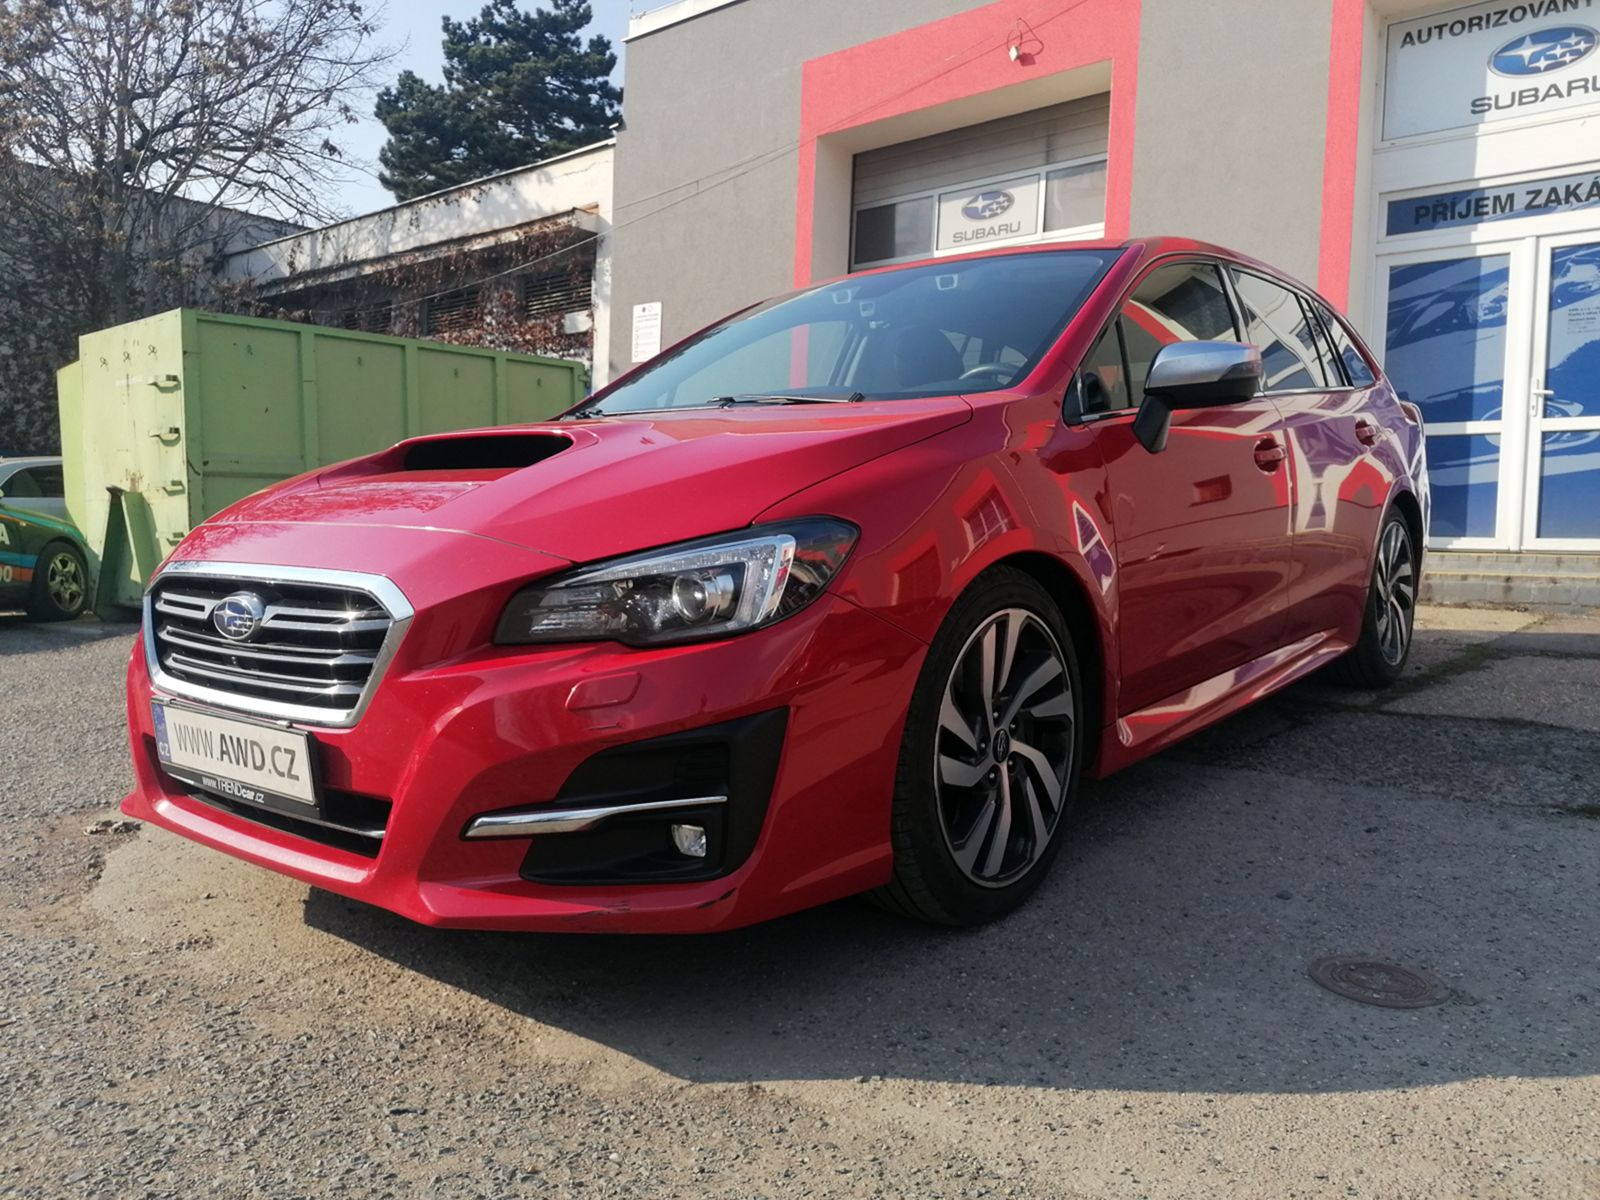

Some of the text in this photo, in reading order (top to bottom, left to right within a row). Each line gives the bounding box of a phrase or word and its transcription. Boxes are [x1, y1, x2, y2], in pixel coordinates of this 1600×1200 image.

[1414, 192, 1515, 225] PŘÍJEM
[953, 221, 1021, 243] SUBARU
[174, 722, 300, 782] WWW.AWD.CZ
